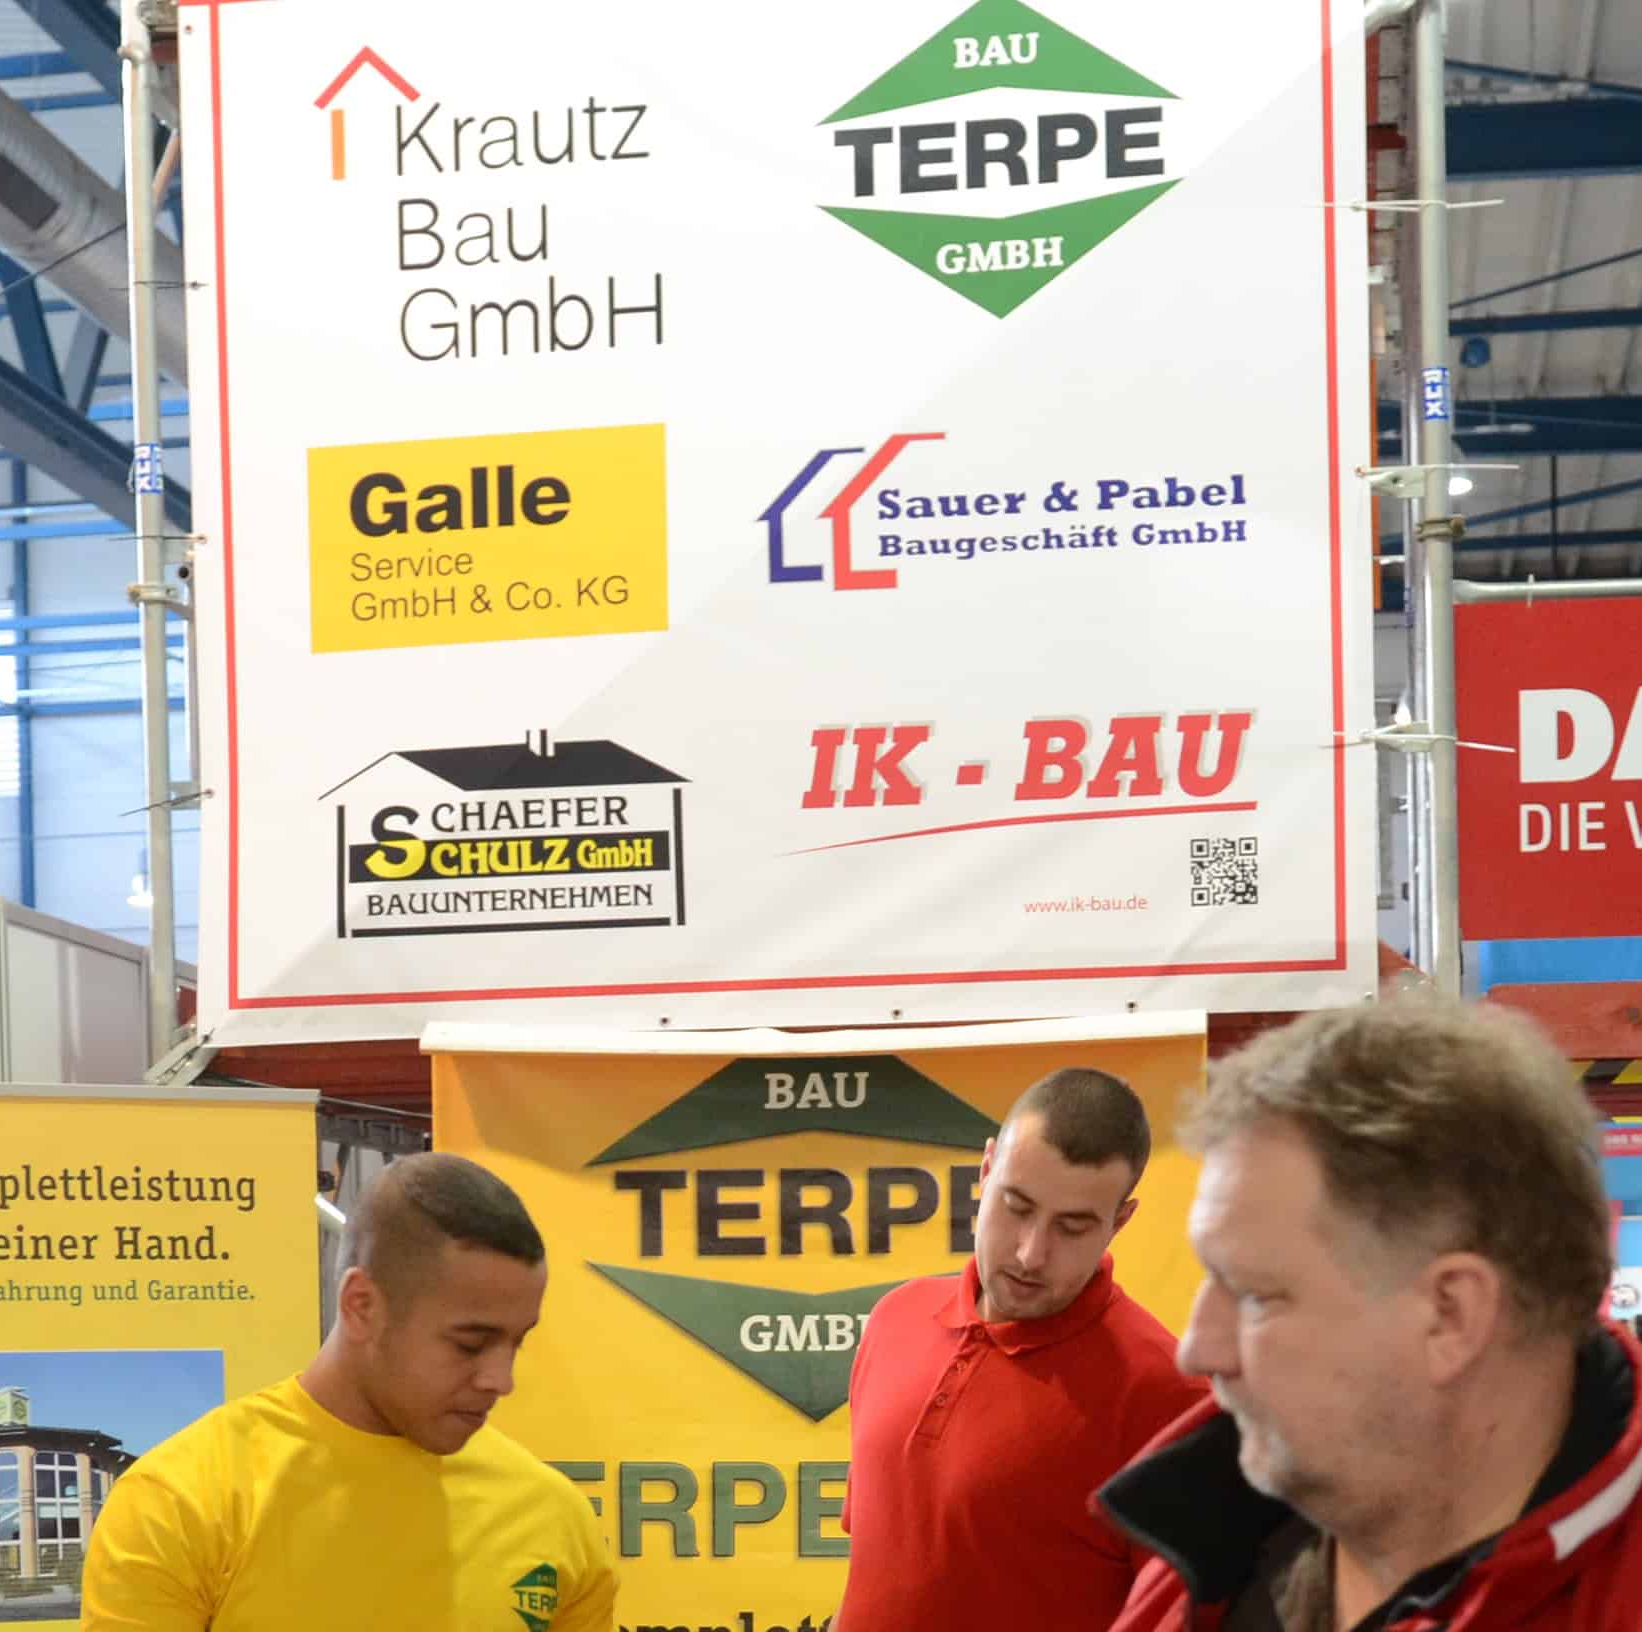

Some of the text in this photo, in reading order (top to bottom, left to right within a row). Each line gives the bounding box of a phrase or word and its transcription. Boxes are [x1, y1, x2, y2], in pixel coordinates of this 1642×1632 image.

[953, 32, 1040, 69] BAU
[395, 97, 650, 178] Krautz
[834, 106, 1165, 199] TERPE
[398, 198, 550, 272] Bau
[935, 237, 1065, 277] GMBH
[398, 274, 665, 361] GmbH
[349, 464, 571, 537] Galle
[877, 474, 1247, 520] Sauer & Pabel
[878, 520, 1248, 560] Baugeschäft GmbH
[350, 548, 474, 582] Service
[351, 574, 630, 622] GmbH & Co. KG
[801, 724, 933, 809] IK
[1013, 711, 1253, 801] BAU
[1518, 799, 1609, 854] DIE
[576, 838, 654, 870] GmbH
[366, 883, 654, 917] BAUUNTERNEHMEN
[1023, 893, 1148, 914] www.ik-bau.de
[764, 1072, 870, 1110] BAU
[114, 1225, 230, 1261] Hand.
[93, 1280, 138, 1302] und
[147, 1280, 256, 1302] Garantie.
